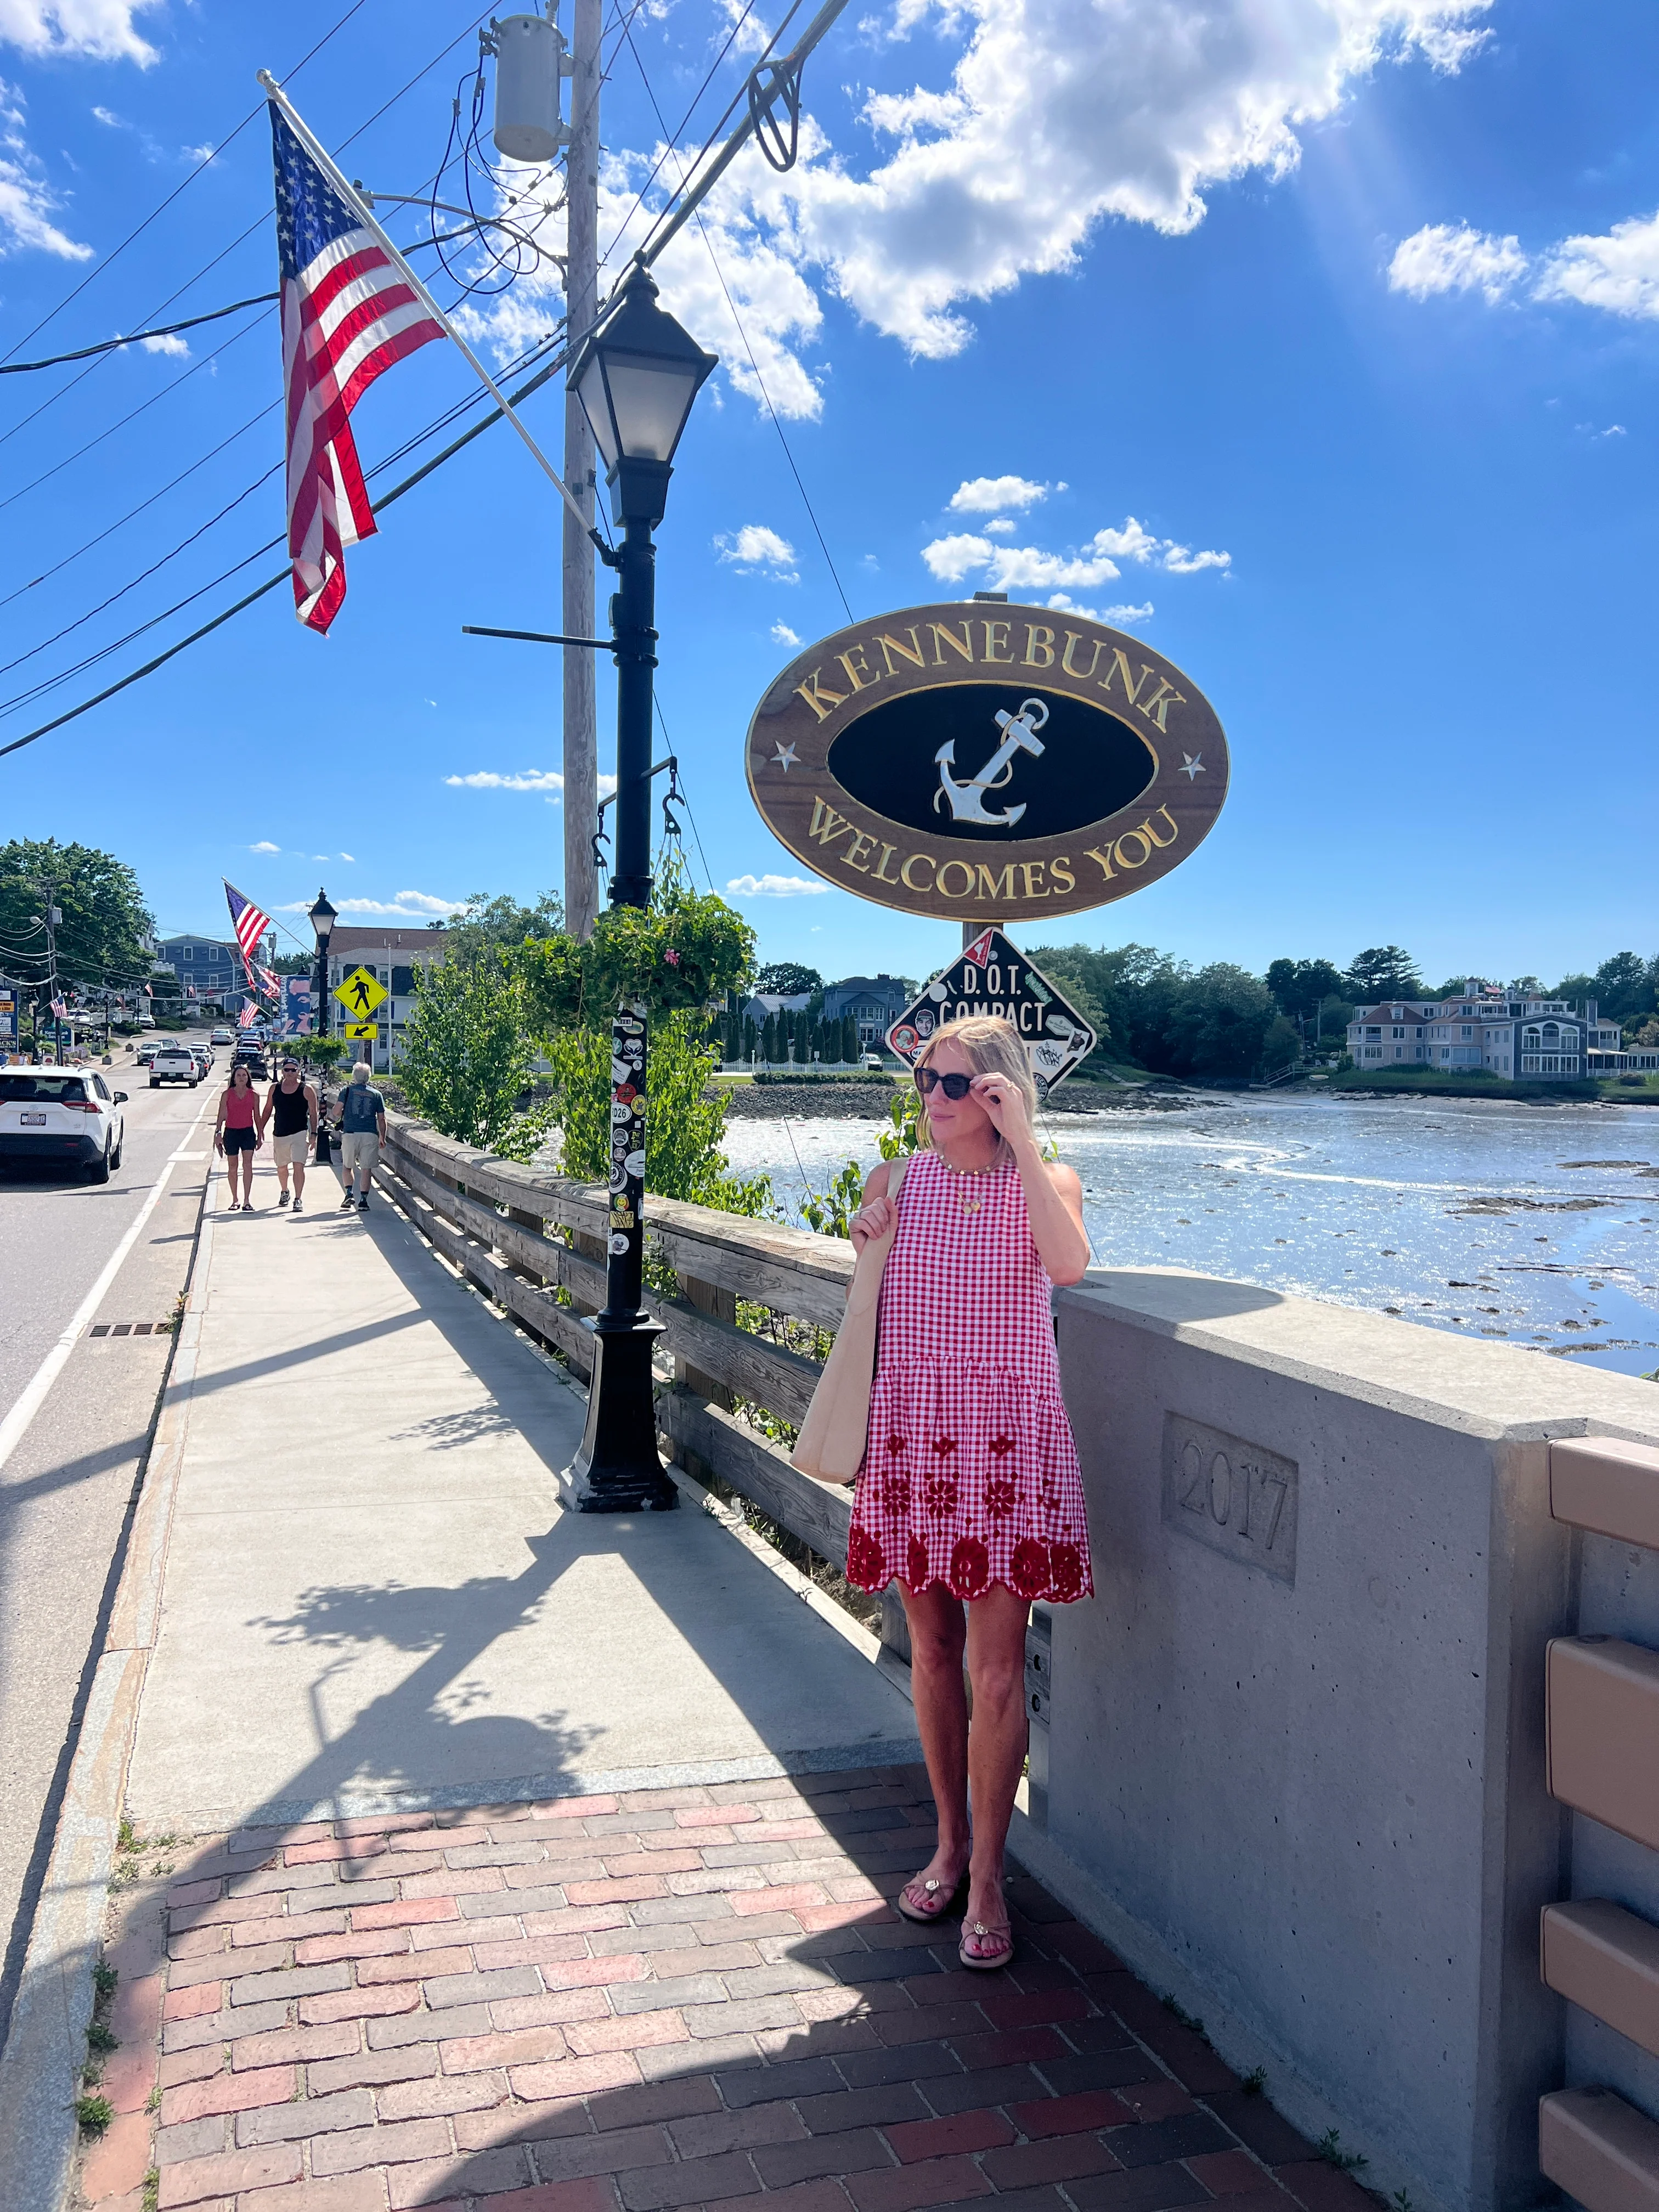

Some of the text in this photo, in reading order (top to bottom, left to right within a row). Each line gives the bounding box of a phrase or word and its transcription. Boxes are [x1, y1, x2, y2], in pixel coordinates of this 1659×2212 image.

[792, 619, 1188, 734] KENNEBUNK
[808, 795, 1180, 900] WELCOMES YOU
[1181, 1438, 1288, 1550] 2017
